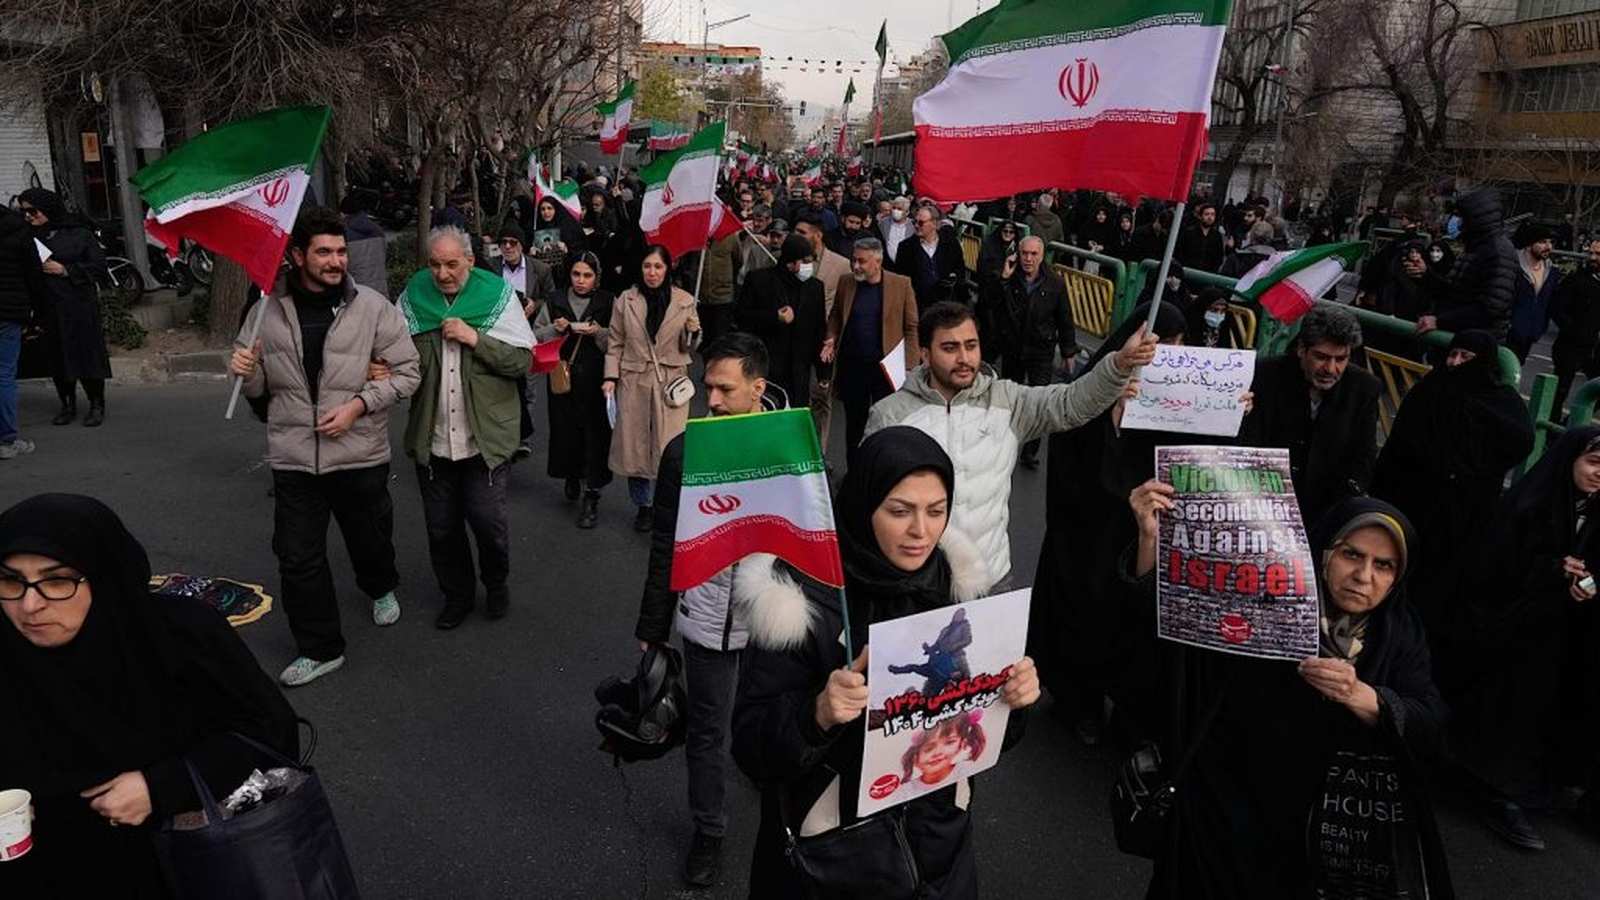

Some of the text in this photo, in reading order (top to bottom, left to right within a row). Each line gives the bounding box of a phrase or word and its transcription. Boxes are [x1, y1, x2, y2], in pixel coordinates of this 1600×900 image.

[1525, 26, 1556, 58] BANK
[1170, 463, 1286, 497] Victory in
[1172, 499, 1292, 522] Second War
[1171, 522, 1298, 556] Against
[1168, 549, 1307, 597] Israel
[884, 707, 923, 736] ۱۴۰۴
[1327, 765, 1400, 793] PANTS
